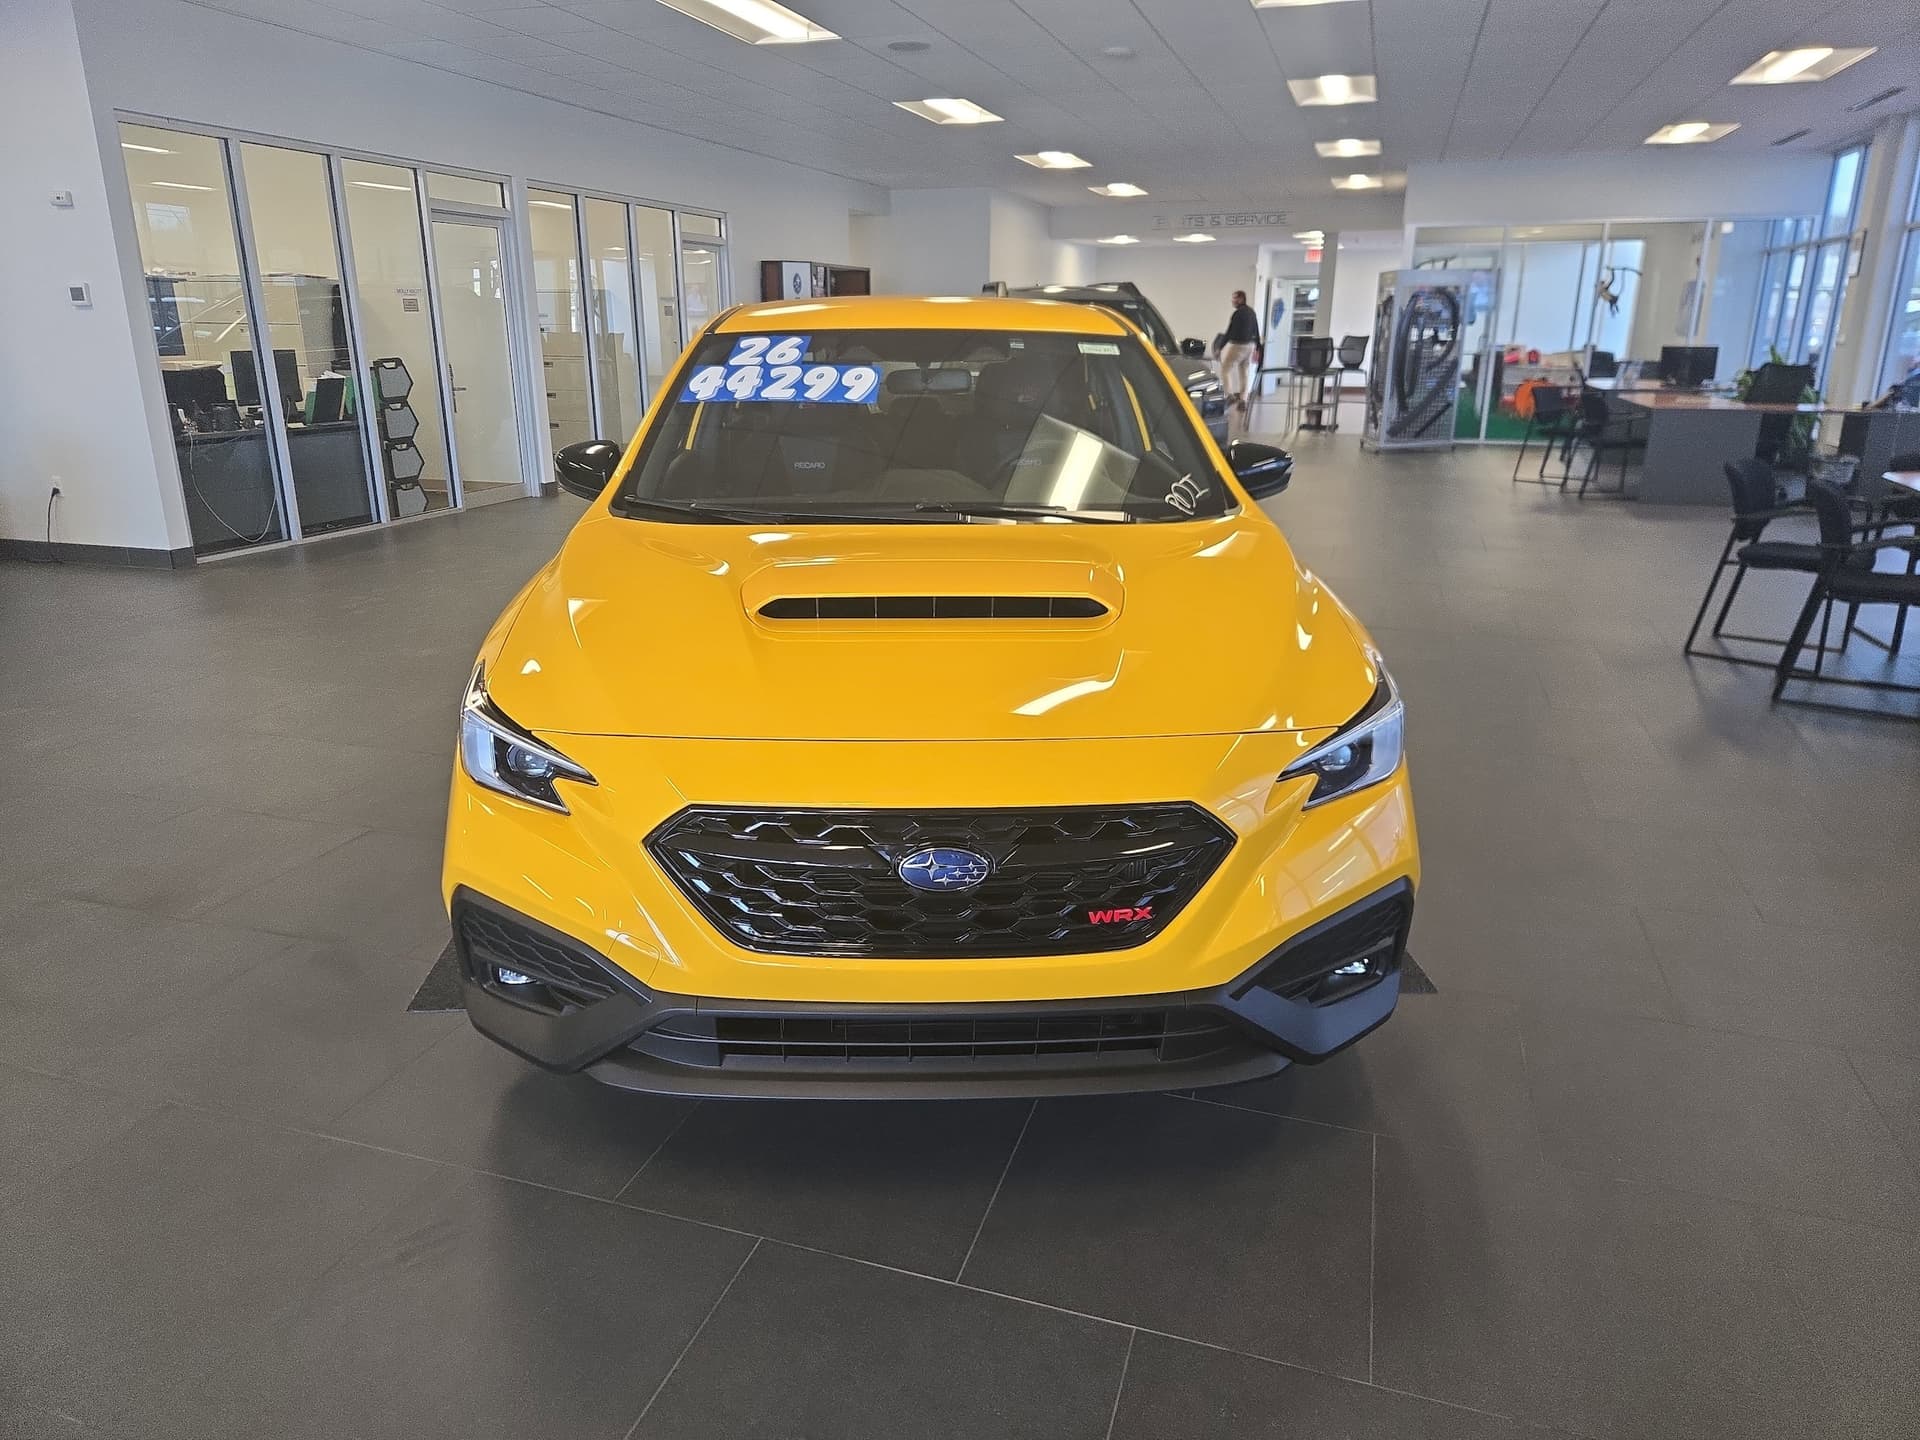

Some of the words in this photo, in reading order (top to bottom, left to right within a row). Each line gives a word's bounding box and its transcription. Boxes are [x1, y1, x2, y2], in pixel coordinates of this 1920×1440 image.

[1225, 212, 1288, 226] SERVICE
[729, 336, 804, 366] 26
[689, 365, 879, 402] 44299
[1088, 906, 1153, 925] WRX
